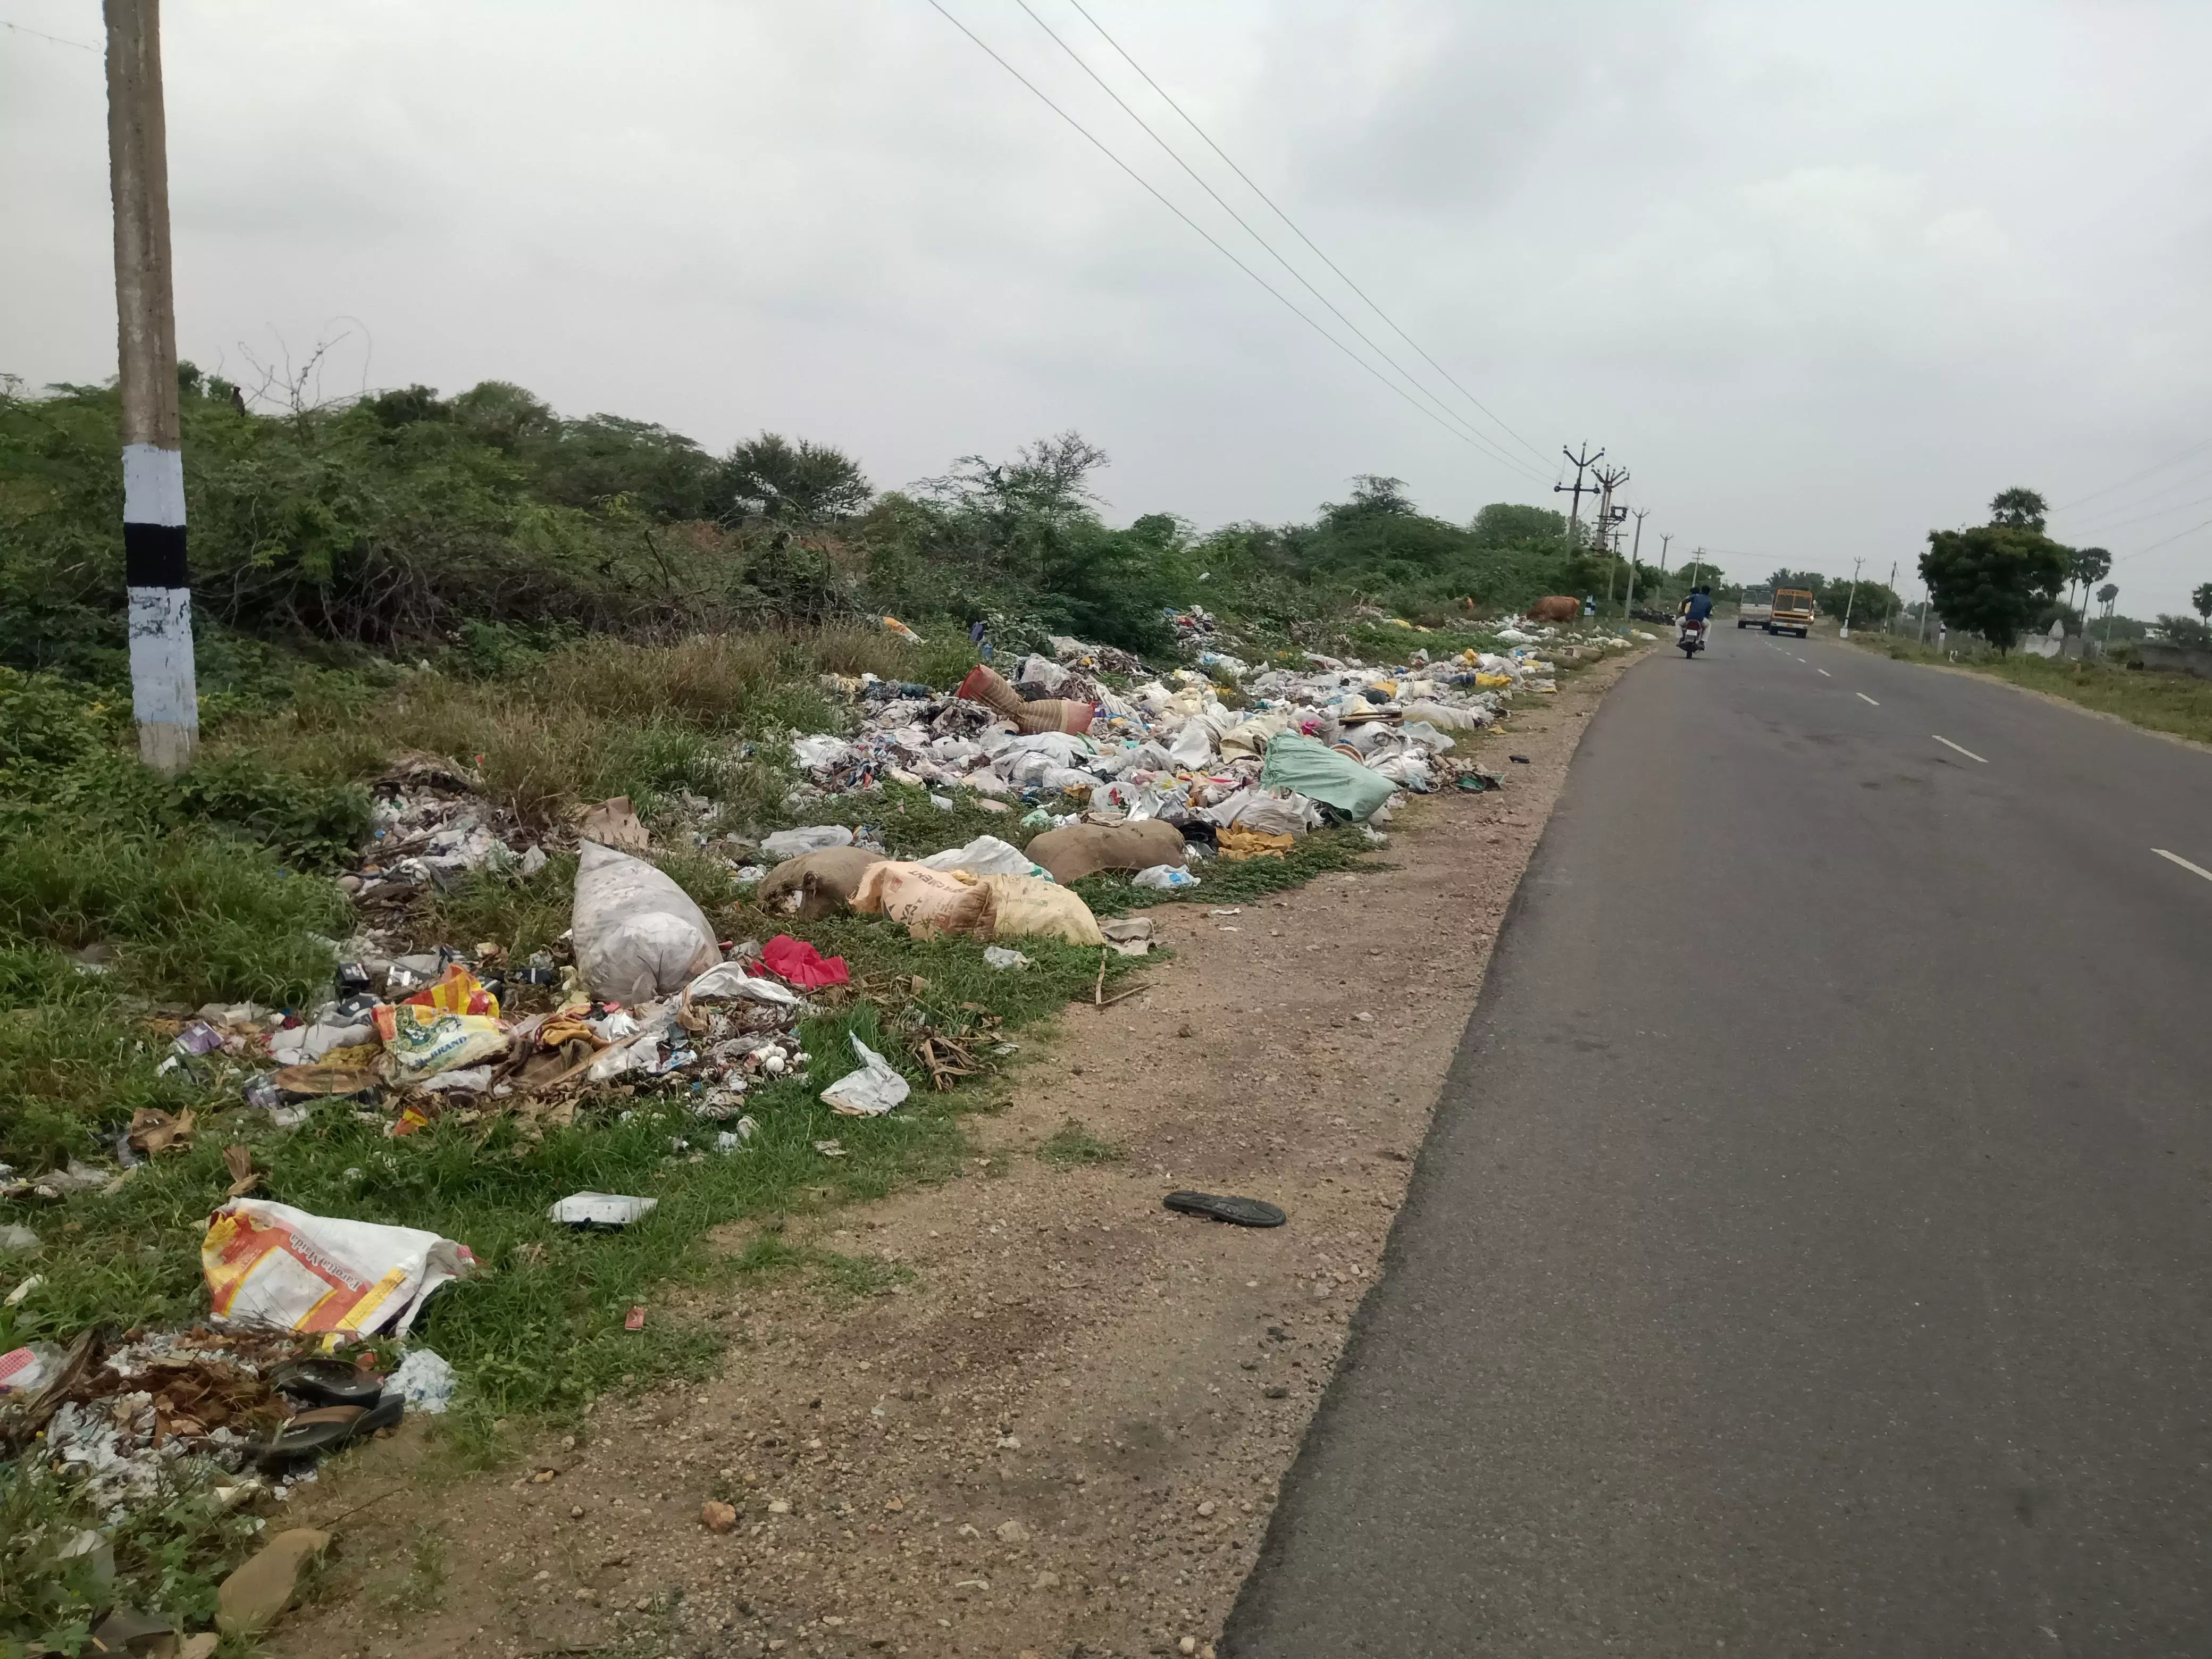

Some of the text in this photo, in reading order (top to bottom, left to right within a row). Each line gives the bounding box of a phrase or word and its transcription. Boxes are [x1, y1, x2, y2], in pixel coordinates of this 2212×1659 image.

[430, 1036, 467, 1060] BRAND
[290, 1233, 320, 1266] Maida
[321, 1257, 363, 1291] Parotta
